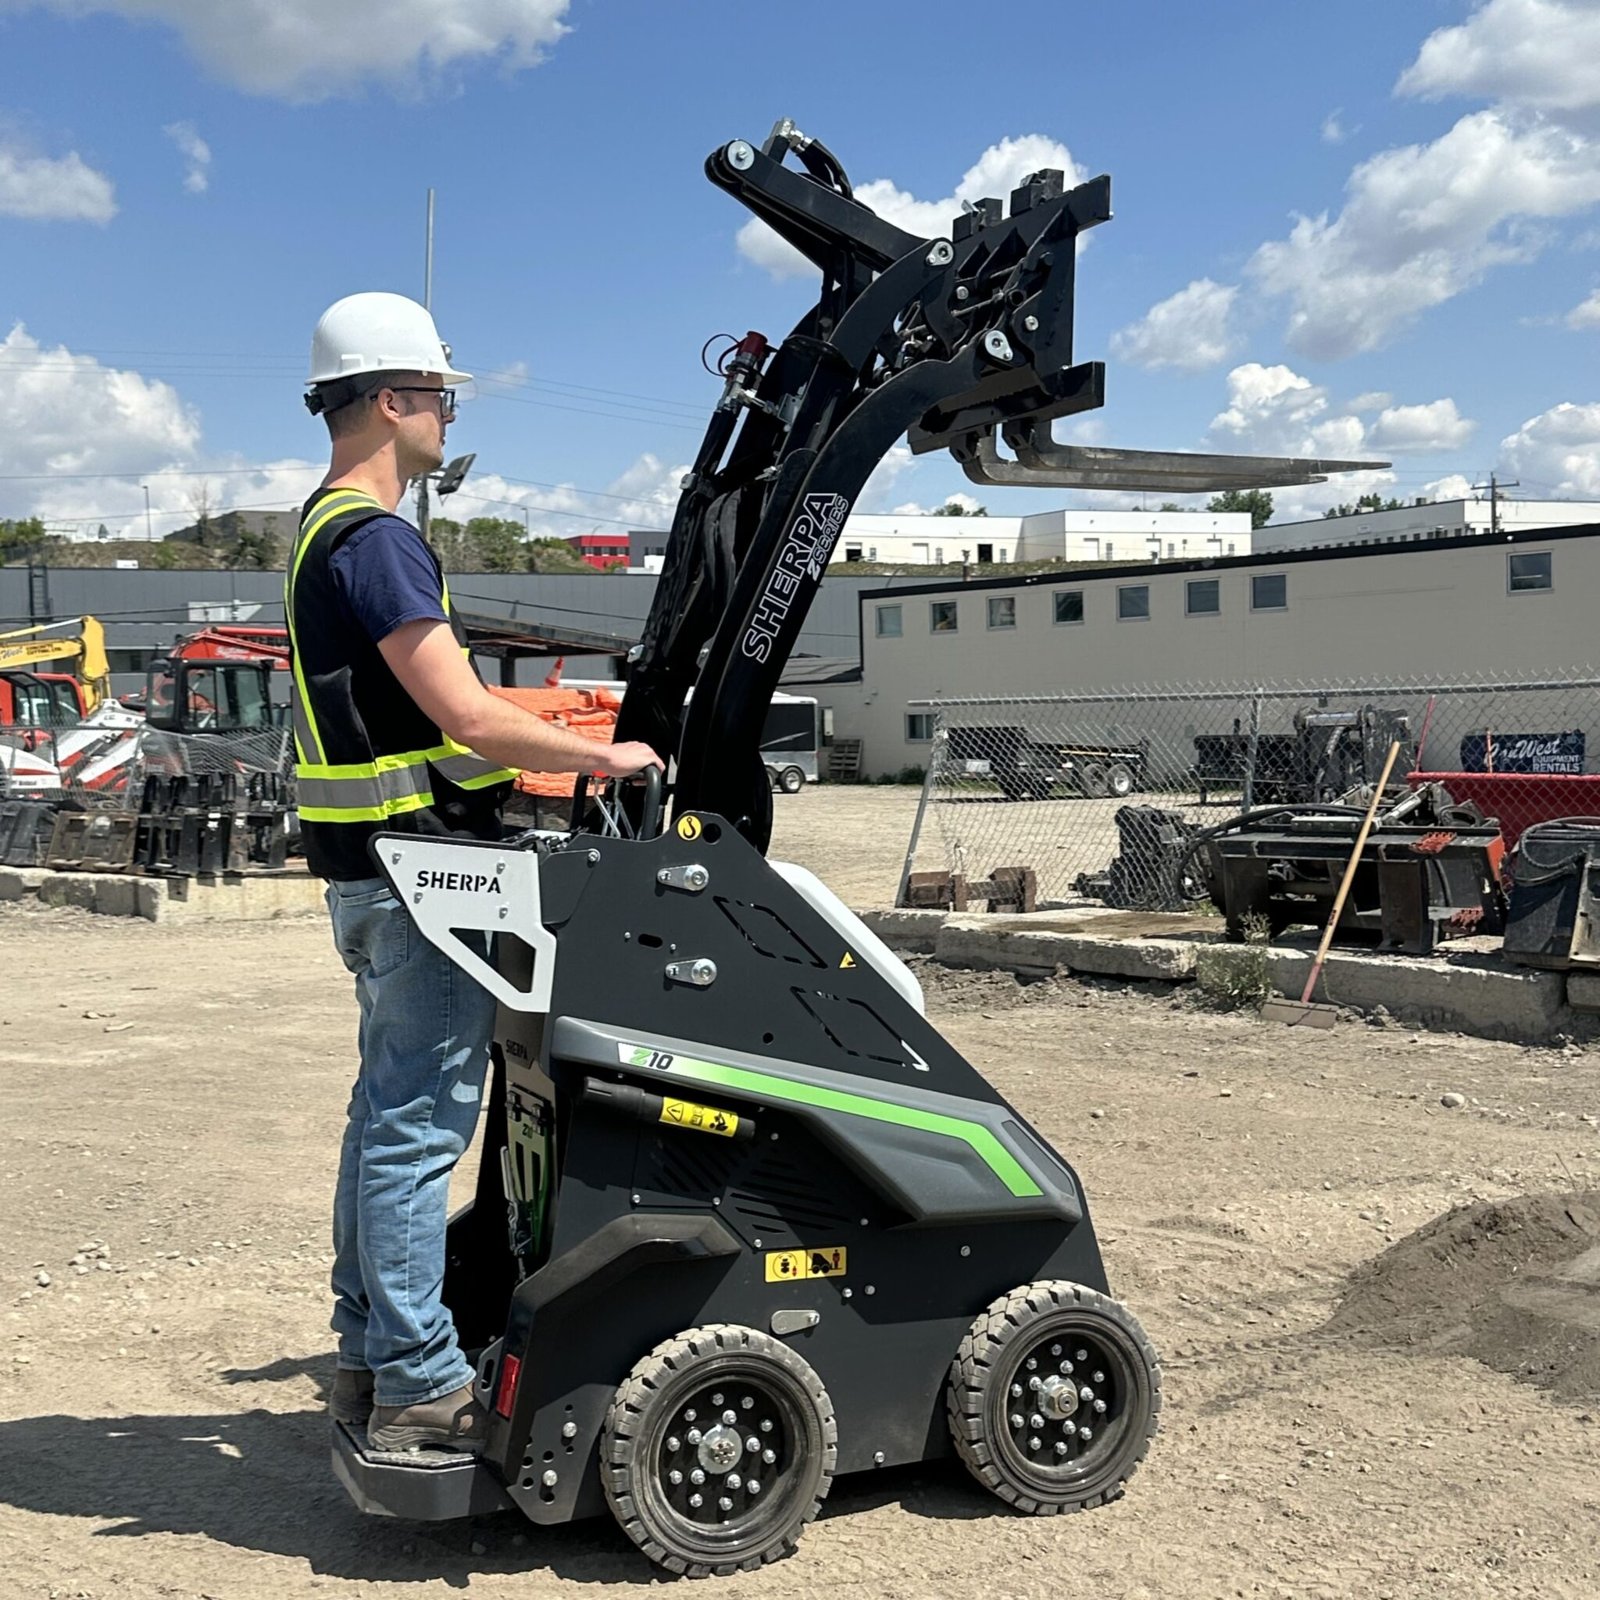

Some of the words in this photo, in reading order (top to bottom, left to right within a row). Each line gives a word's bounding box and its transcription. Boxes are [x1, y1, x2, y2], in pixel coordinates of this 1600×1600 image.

[741, 493, 838, 664] SHERPA
[1532, 754, 1580, 763] EQUIPMENT
[1532, 763, 1580, 773] RENTALS
[416, 870, 502, 894] SHERPA
[630, 1048, 674, 1070] Z10
